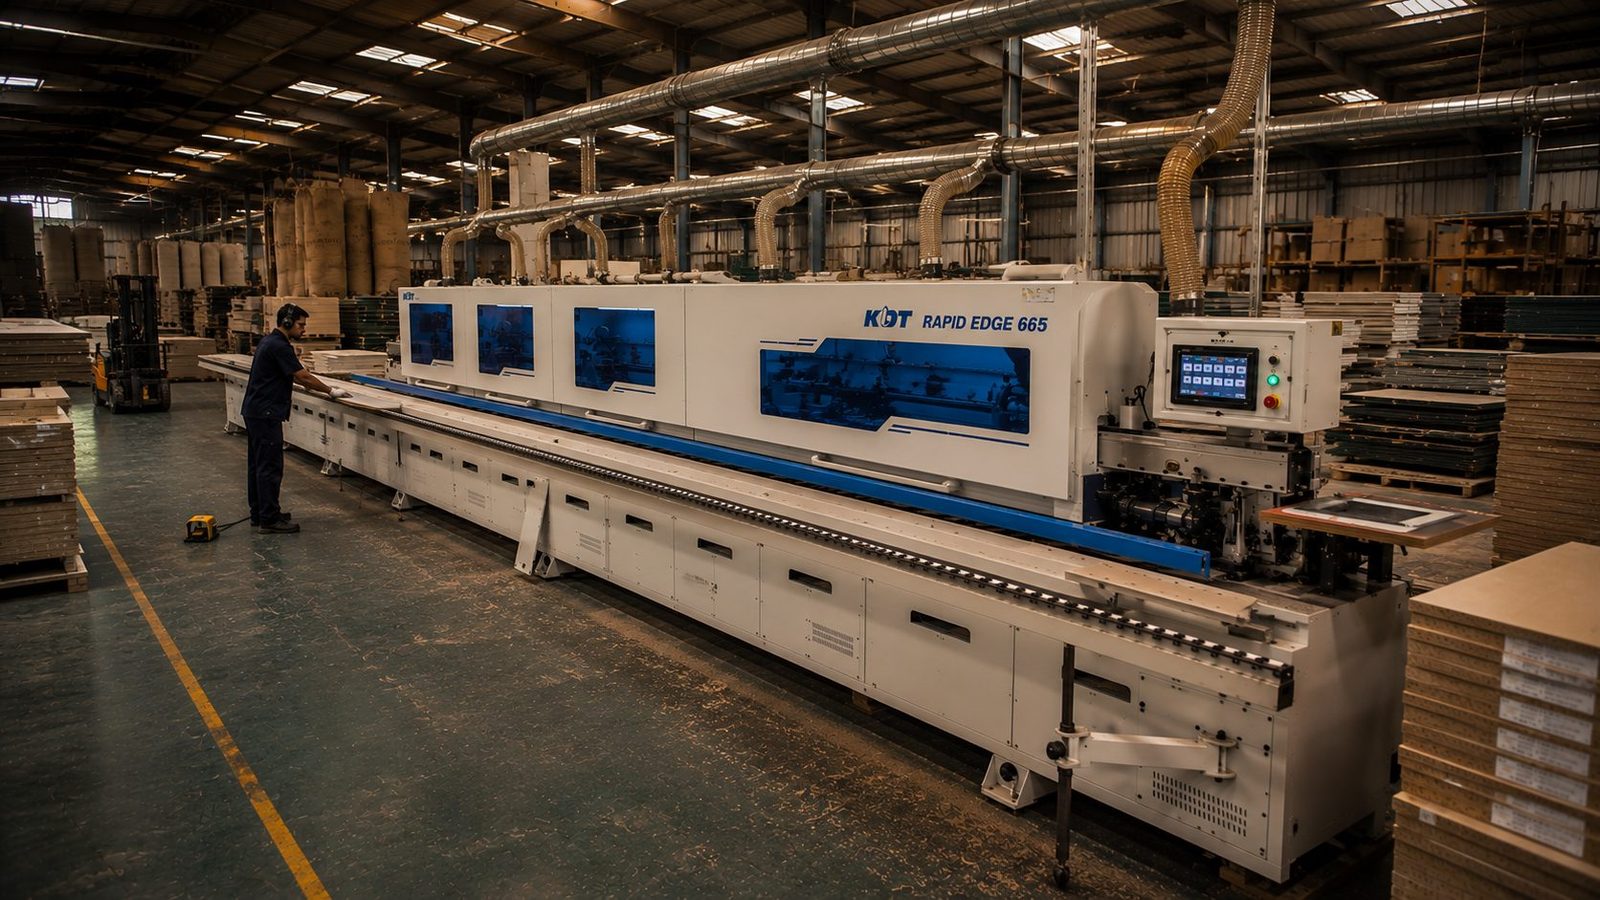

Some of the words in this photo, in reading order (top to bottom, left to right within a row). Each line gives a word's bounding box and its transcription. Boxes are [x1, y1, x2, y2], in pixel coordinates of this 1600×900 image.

[864, 306, 913, 328] KDT
[922, 315, 966, 330] RAPID
[970, 316, 1013, 331] EDGE
[1017, 317, 1048, 332] 665
